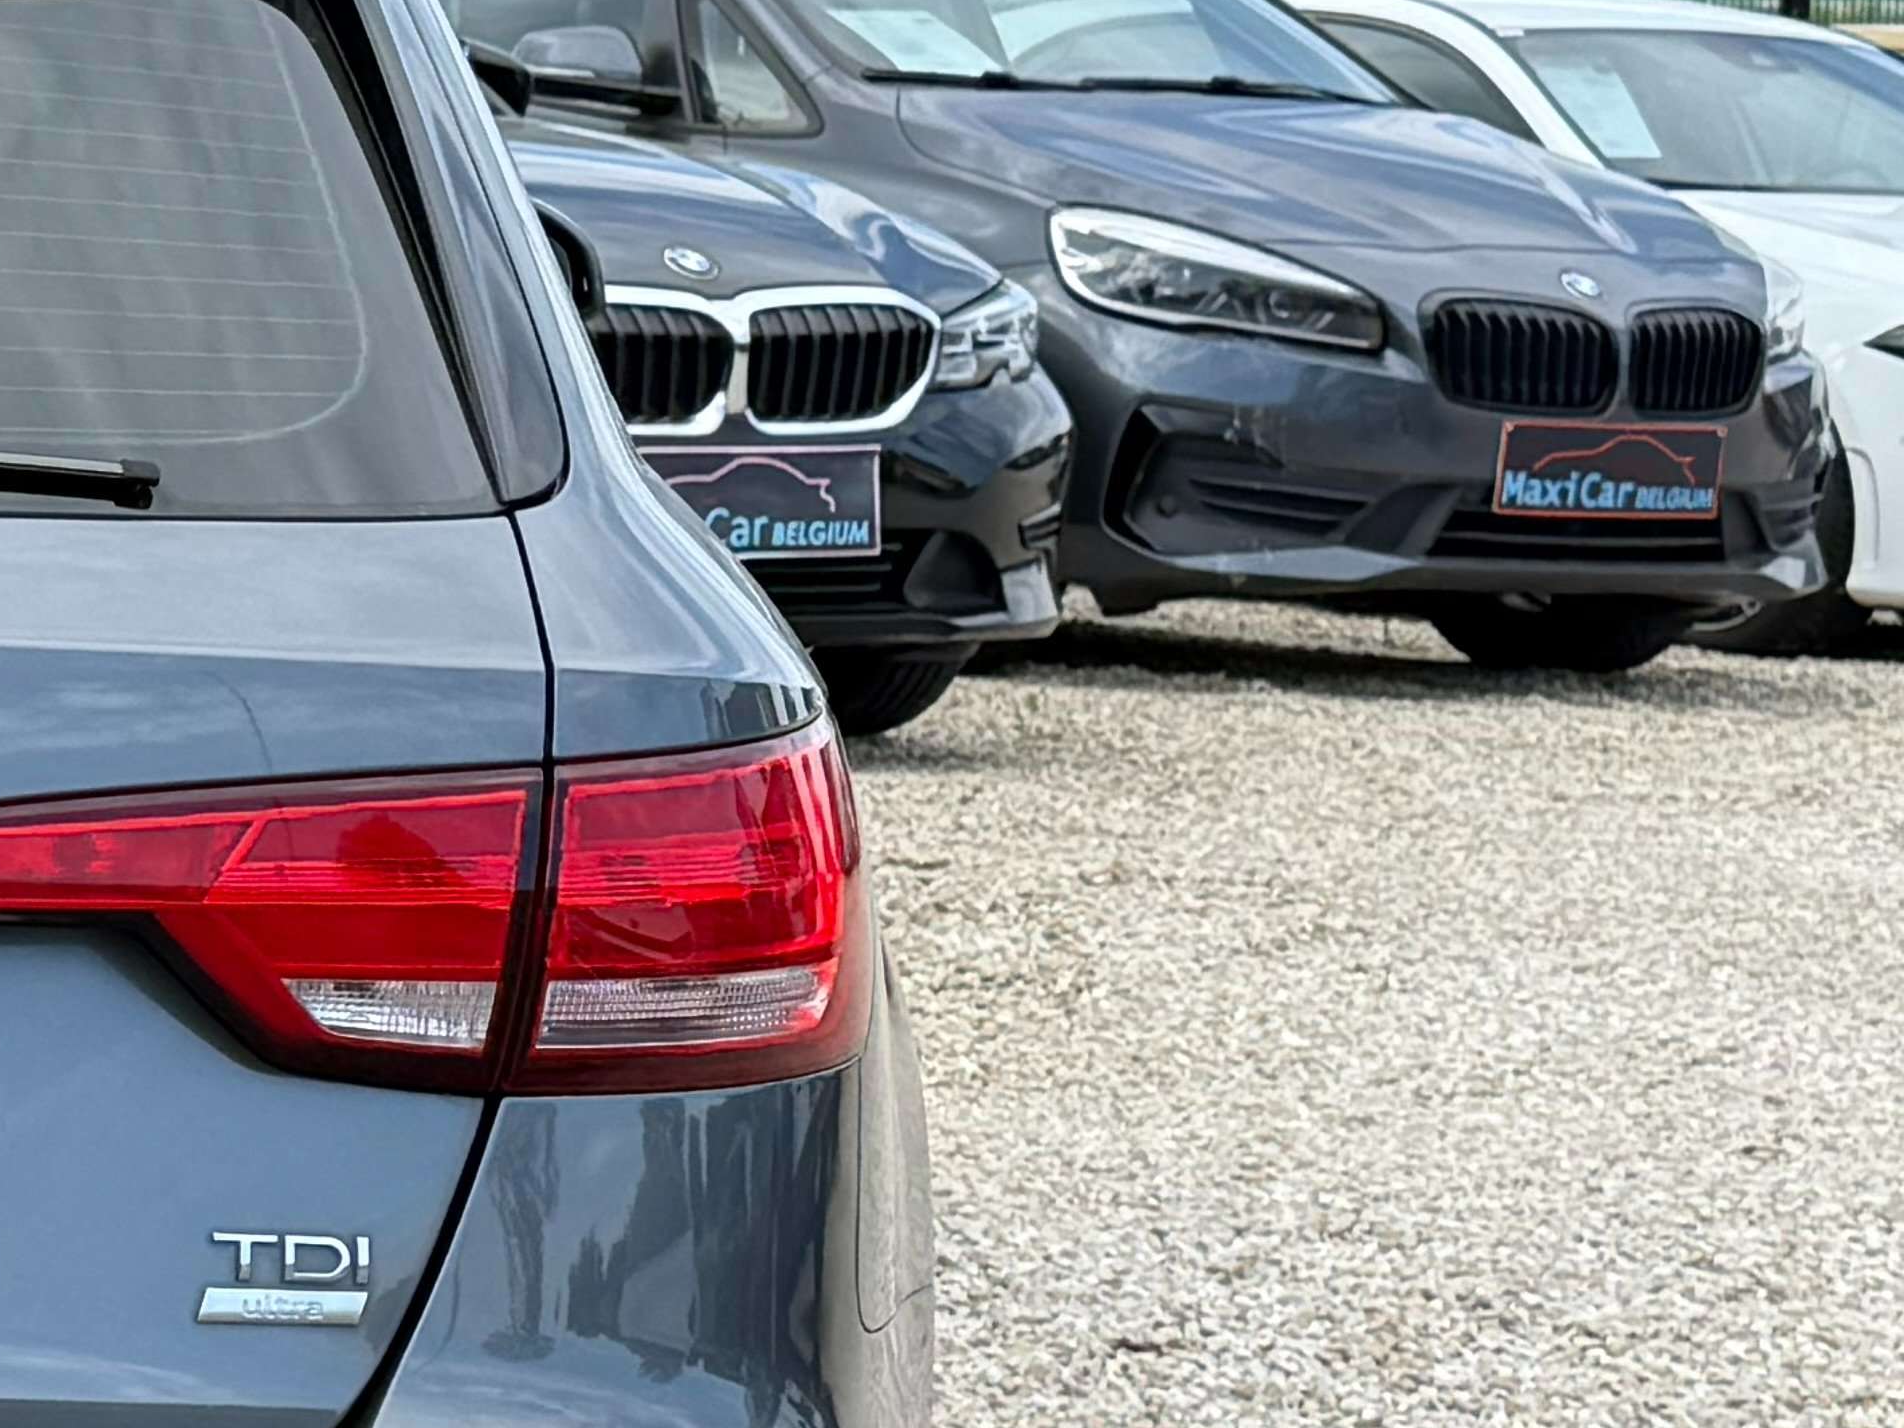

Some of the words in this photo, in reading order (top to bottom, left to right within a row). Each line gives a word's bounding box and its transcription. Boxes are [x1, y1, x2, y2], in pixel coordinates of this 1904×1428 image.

[1635, 486, 1713, 510] BELGIUM
[771, 519, 870, 547] BELGIUM
[211, 1231, 370, 1285] TDI
